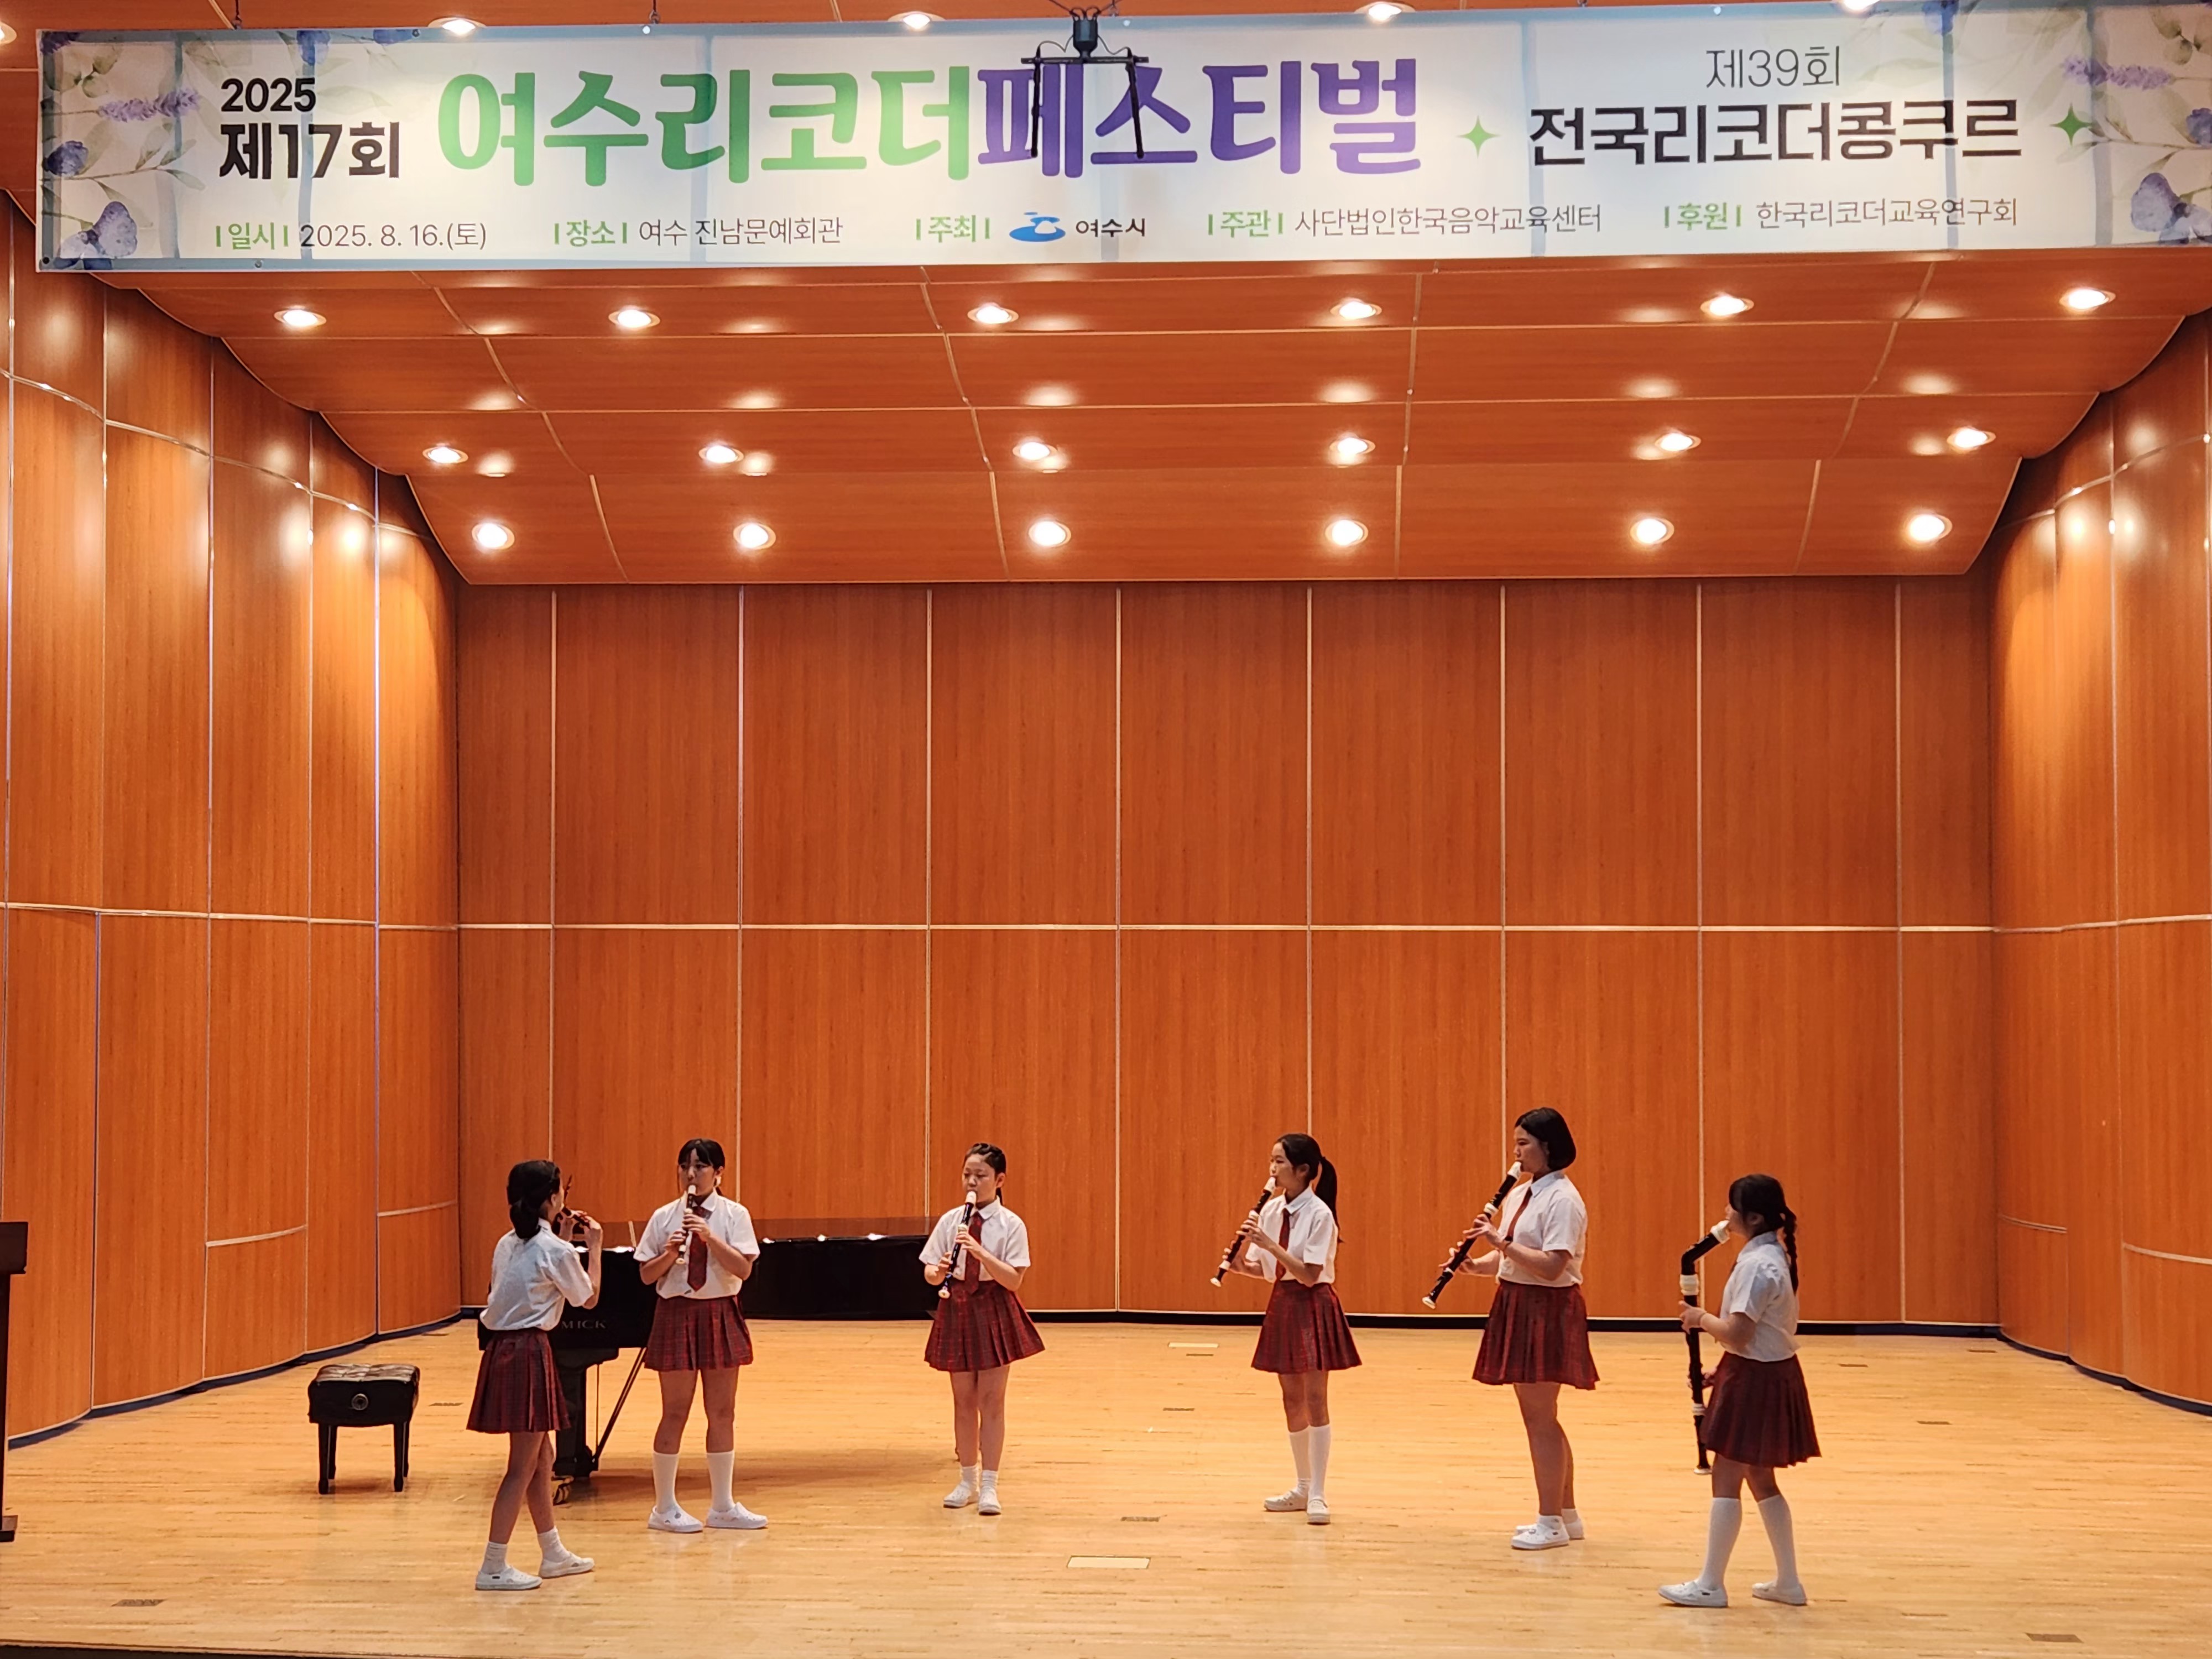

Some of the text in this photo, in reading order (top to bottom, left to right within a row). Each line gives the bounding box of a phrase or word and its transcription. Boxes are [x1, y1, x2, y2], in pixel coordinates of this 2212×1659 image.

[1707, 46, 1839, 88] 제39회
[221, 77, 316, 113] 2025
[1530, 99, 2022, 166] 전국리코더콩쿠르
[220, 122, 399, 180] 제17회
[1076, 218, 1146, 238] 여수시
[1295, 205, 1600, 237] 사단법인한국음악교육센터
[1757, 197, 2016, 228] 한국리코더교육연구회
[639, 219, 687, 246] 여수
[695, 217, 843, 245] 진남문예회관
[561, 1320, 607, 1329] MICK
